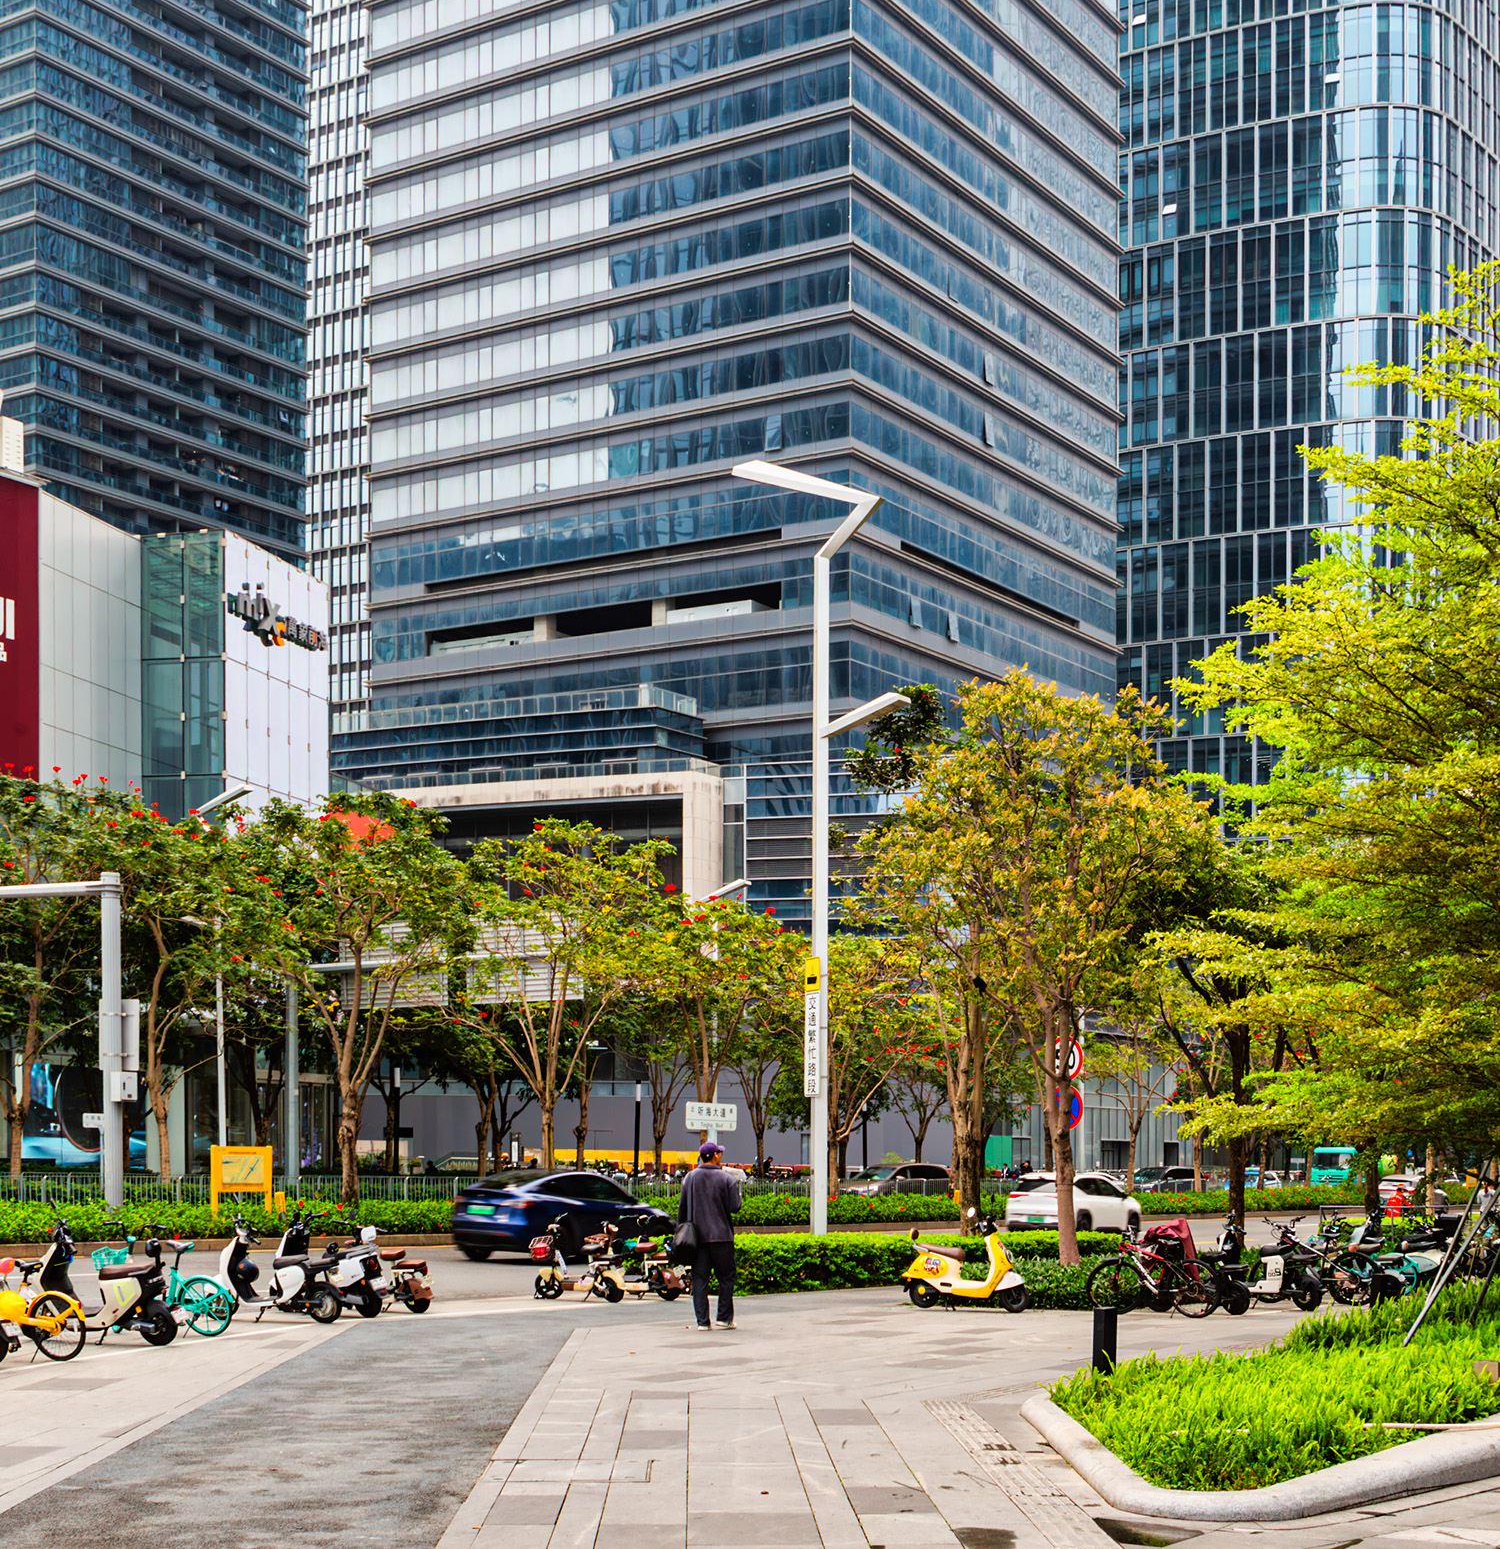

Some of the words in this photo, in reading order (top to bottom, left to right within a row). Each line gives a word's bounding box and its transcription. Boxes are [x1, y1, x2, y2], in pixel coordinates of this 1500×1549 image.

[807, 995, 817, 1093] 交通繁忙路段
[697, 1106, 726, 1118] 听海大道
